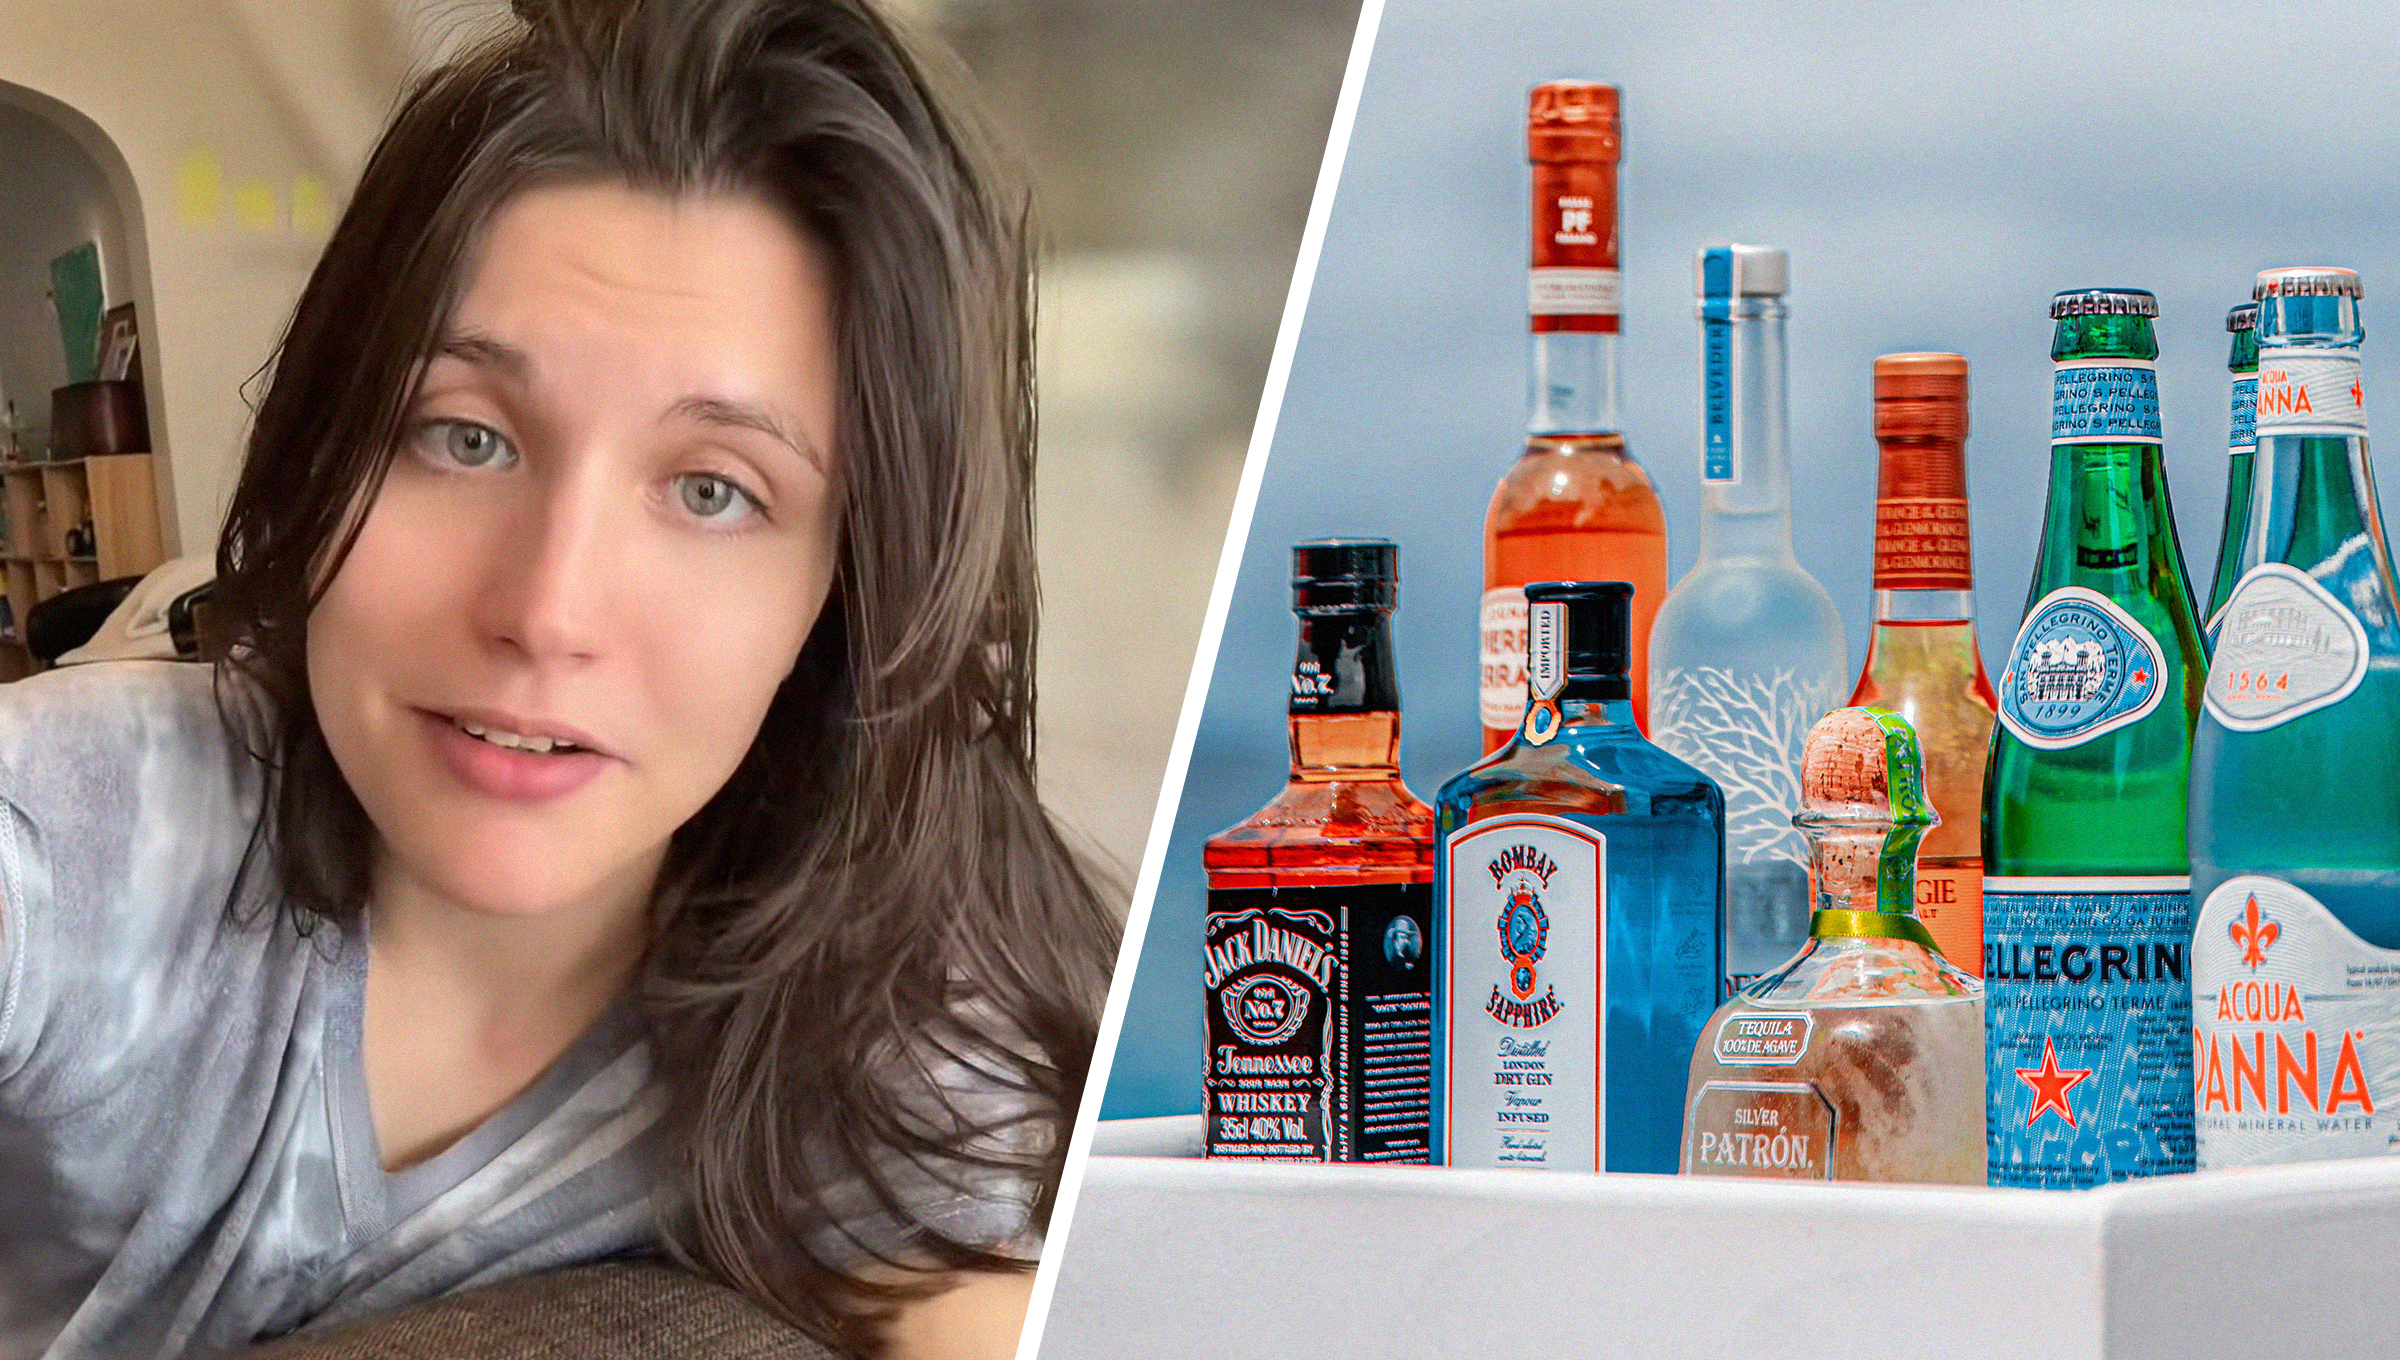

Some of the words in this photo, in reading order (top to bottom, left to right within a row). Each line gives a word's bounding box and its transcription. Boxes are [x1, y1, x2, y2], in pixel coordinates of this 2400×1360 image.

[1711, 319, 1723, 424] BELVEDER
[2053, 389, 2087, 402] GRINO
[2093, 388, 2158, 401] S.PELLEG
[2052, 419, 2087, 432] GRINO
[1540, 610, 1551, 679] IMPORTED
[2022, 613, 2108, 662] PELLEGRINO
[2095, 643, 2119, 704] TERME
[2227, 668, 2289, 692] 1564
[2019, 671, 2030, 705] SAN
[2034, 703, 2082, 719] 1899
[1487, 844, 1558, 891] BOMBAY
[1917, 879, 1958, 905] GIE
[1203, 929, 1255, 991] JACK
[1252, 917, 1341, 994] DANIEL'S
[1986, 943, 2191, 982] ELLEGRIN
[1993, 996, 2012, 1010] SAN
[2015, 995, 2105, 1011] PELLEGRINO
[2112, 996, 2163, 1011] TERME
[2218, 981, 2305, 1023] ACQUA
[1738, 1021, 1793, 1038] TEQUILA
[1497, 1036, 1552, 1058] Distilled
[1746, 1040, 1762, 1055] DE
[1761, 1040, 1798, 1055] AGAVE
[1216, 1043, 1313, 1076] Tennessee
[1502, 1060, 1546, 1071] LONDON
[1493, 1071, 1525, 1086] DRY
[1525, 1071, 1554, 1086] GIN
[2194, 1027, 2375, 1116] PANNA
[1217, 1092, 1312, 1114] WHISKEY
[1503, 1089, 1543, 1110] Vapour
[1219, 1115, 1249, 1141] 35cl
[1248, 1115, 1281, 1141] 40%
[1281, 1115, 1308, 1141] Vol.
[1497, 1111, 1550, 1123] INFUSED
[1734, 1107, 1779, 1127] SILVER
[2238, 1117, 2306, 1131] MINERAL
[2317, 1117, 2374, 1131] WATER
[1212, 1142, 1251, 1156] DISTILLED
[1249, 1142, 1267, 1156] AND
[1300, 1143, 1316, 1156] BY
